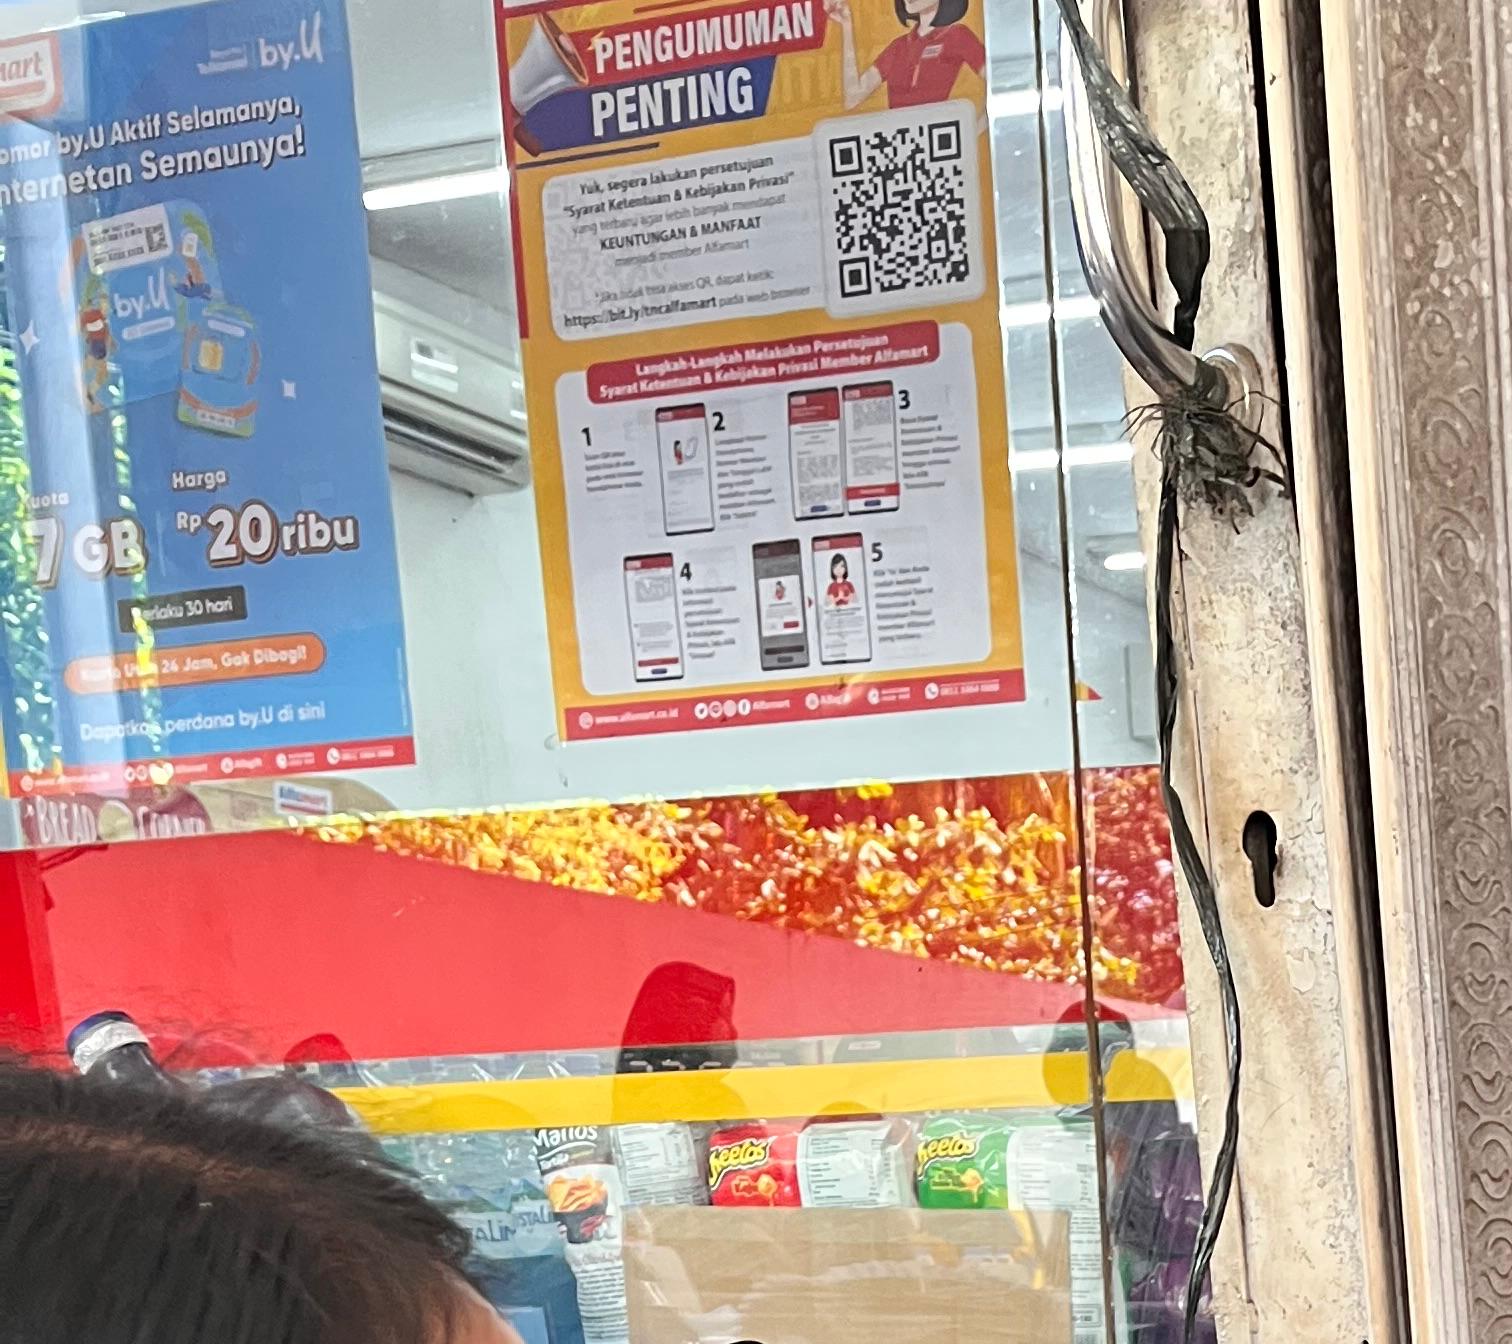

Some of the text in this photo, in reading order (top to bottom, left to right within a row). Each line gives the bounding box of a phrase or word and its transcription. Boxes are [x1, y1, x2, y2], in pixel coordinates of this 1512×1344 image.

[258, 10, 324, 71] by.U
[594, 1, 814, 74] PENGUMUMAN
[591, 66, 754, 136] PENTING
[58, 123, 105, 157] by.U
[110, 113, 161, 148] Aktif
[167, 95, 302, 135] Selamanya,
[140, 124, 306, 181] Semaunya!
[579, 156, 773, 195] Yuk, segera lakukan persetujuan
[608, 193, 671, 211] Ketentuan
[673, 188, 682, 201] &
[685, 181, 746, 199] Kebijakan
[600, 216, 762, 250] KEUNTUNGAN & MANFAAT
[113, 267, 170, 319] by.U
[898, 389, 911, 410] 3
[580, 426, 592, 447] 1
[712, 411, 726, 432] 2
[171, 469, 228, 491] Harga
[73, 518, 146, 575] GB
[175, 502, 356, 562] Rp 20 ribu
[871, 542, 883, 562] 5
[680, 562, 693, 582] 4
[133, 595, 233, 622] erlaku 30 hari
[163, 709, 235, 737] perdana
[238, 704, 274, 730] by.U
[277, 704, 294, 723] di
[298, 700, 326, 721] sini
